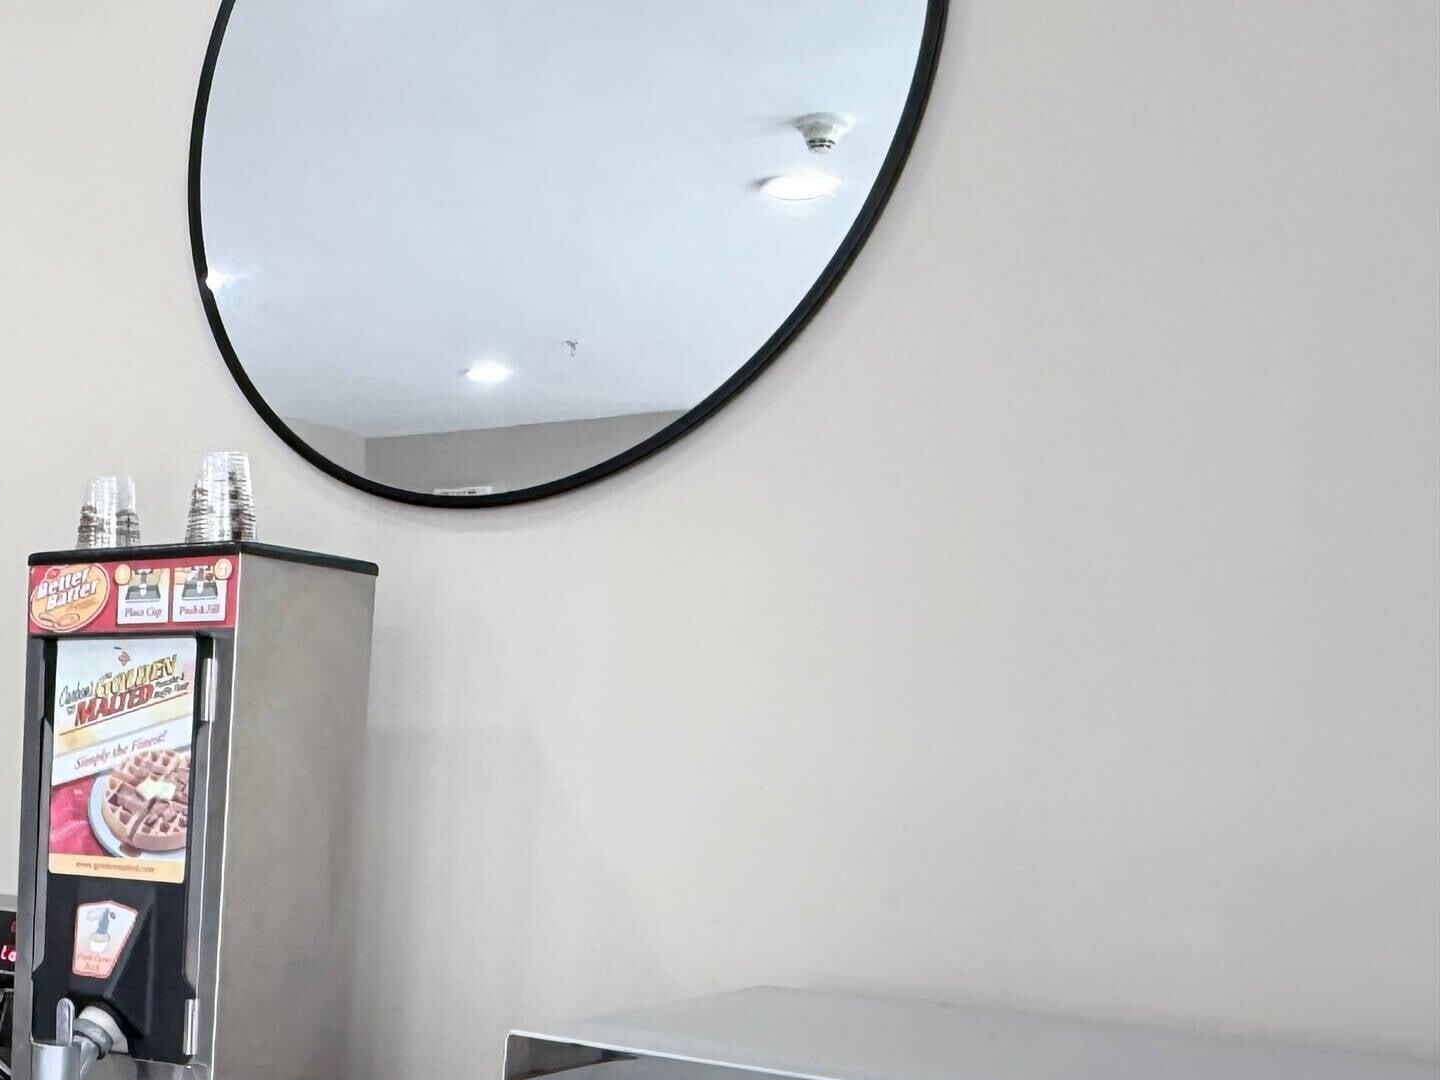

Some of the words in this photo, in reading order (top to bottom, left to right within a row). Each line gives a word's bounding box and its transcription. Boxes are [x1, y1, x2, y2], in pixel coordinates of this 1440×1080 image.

[95, 654, 177, 697] GOLDEN
[75, 684, 154, 726] MALTED
[75, 749, 110, 770] Simply
[113, 744, 128, 756] the
